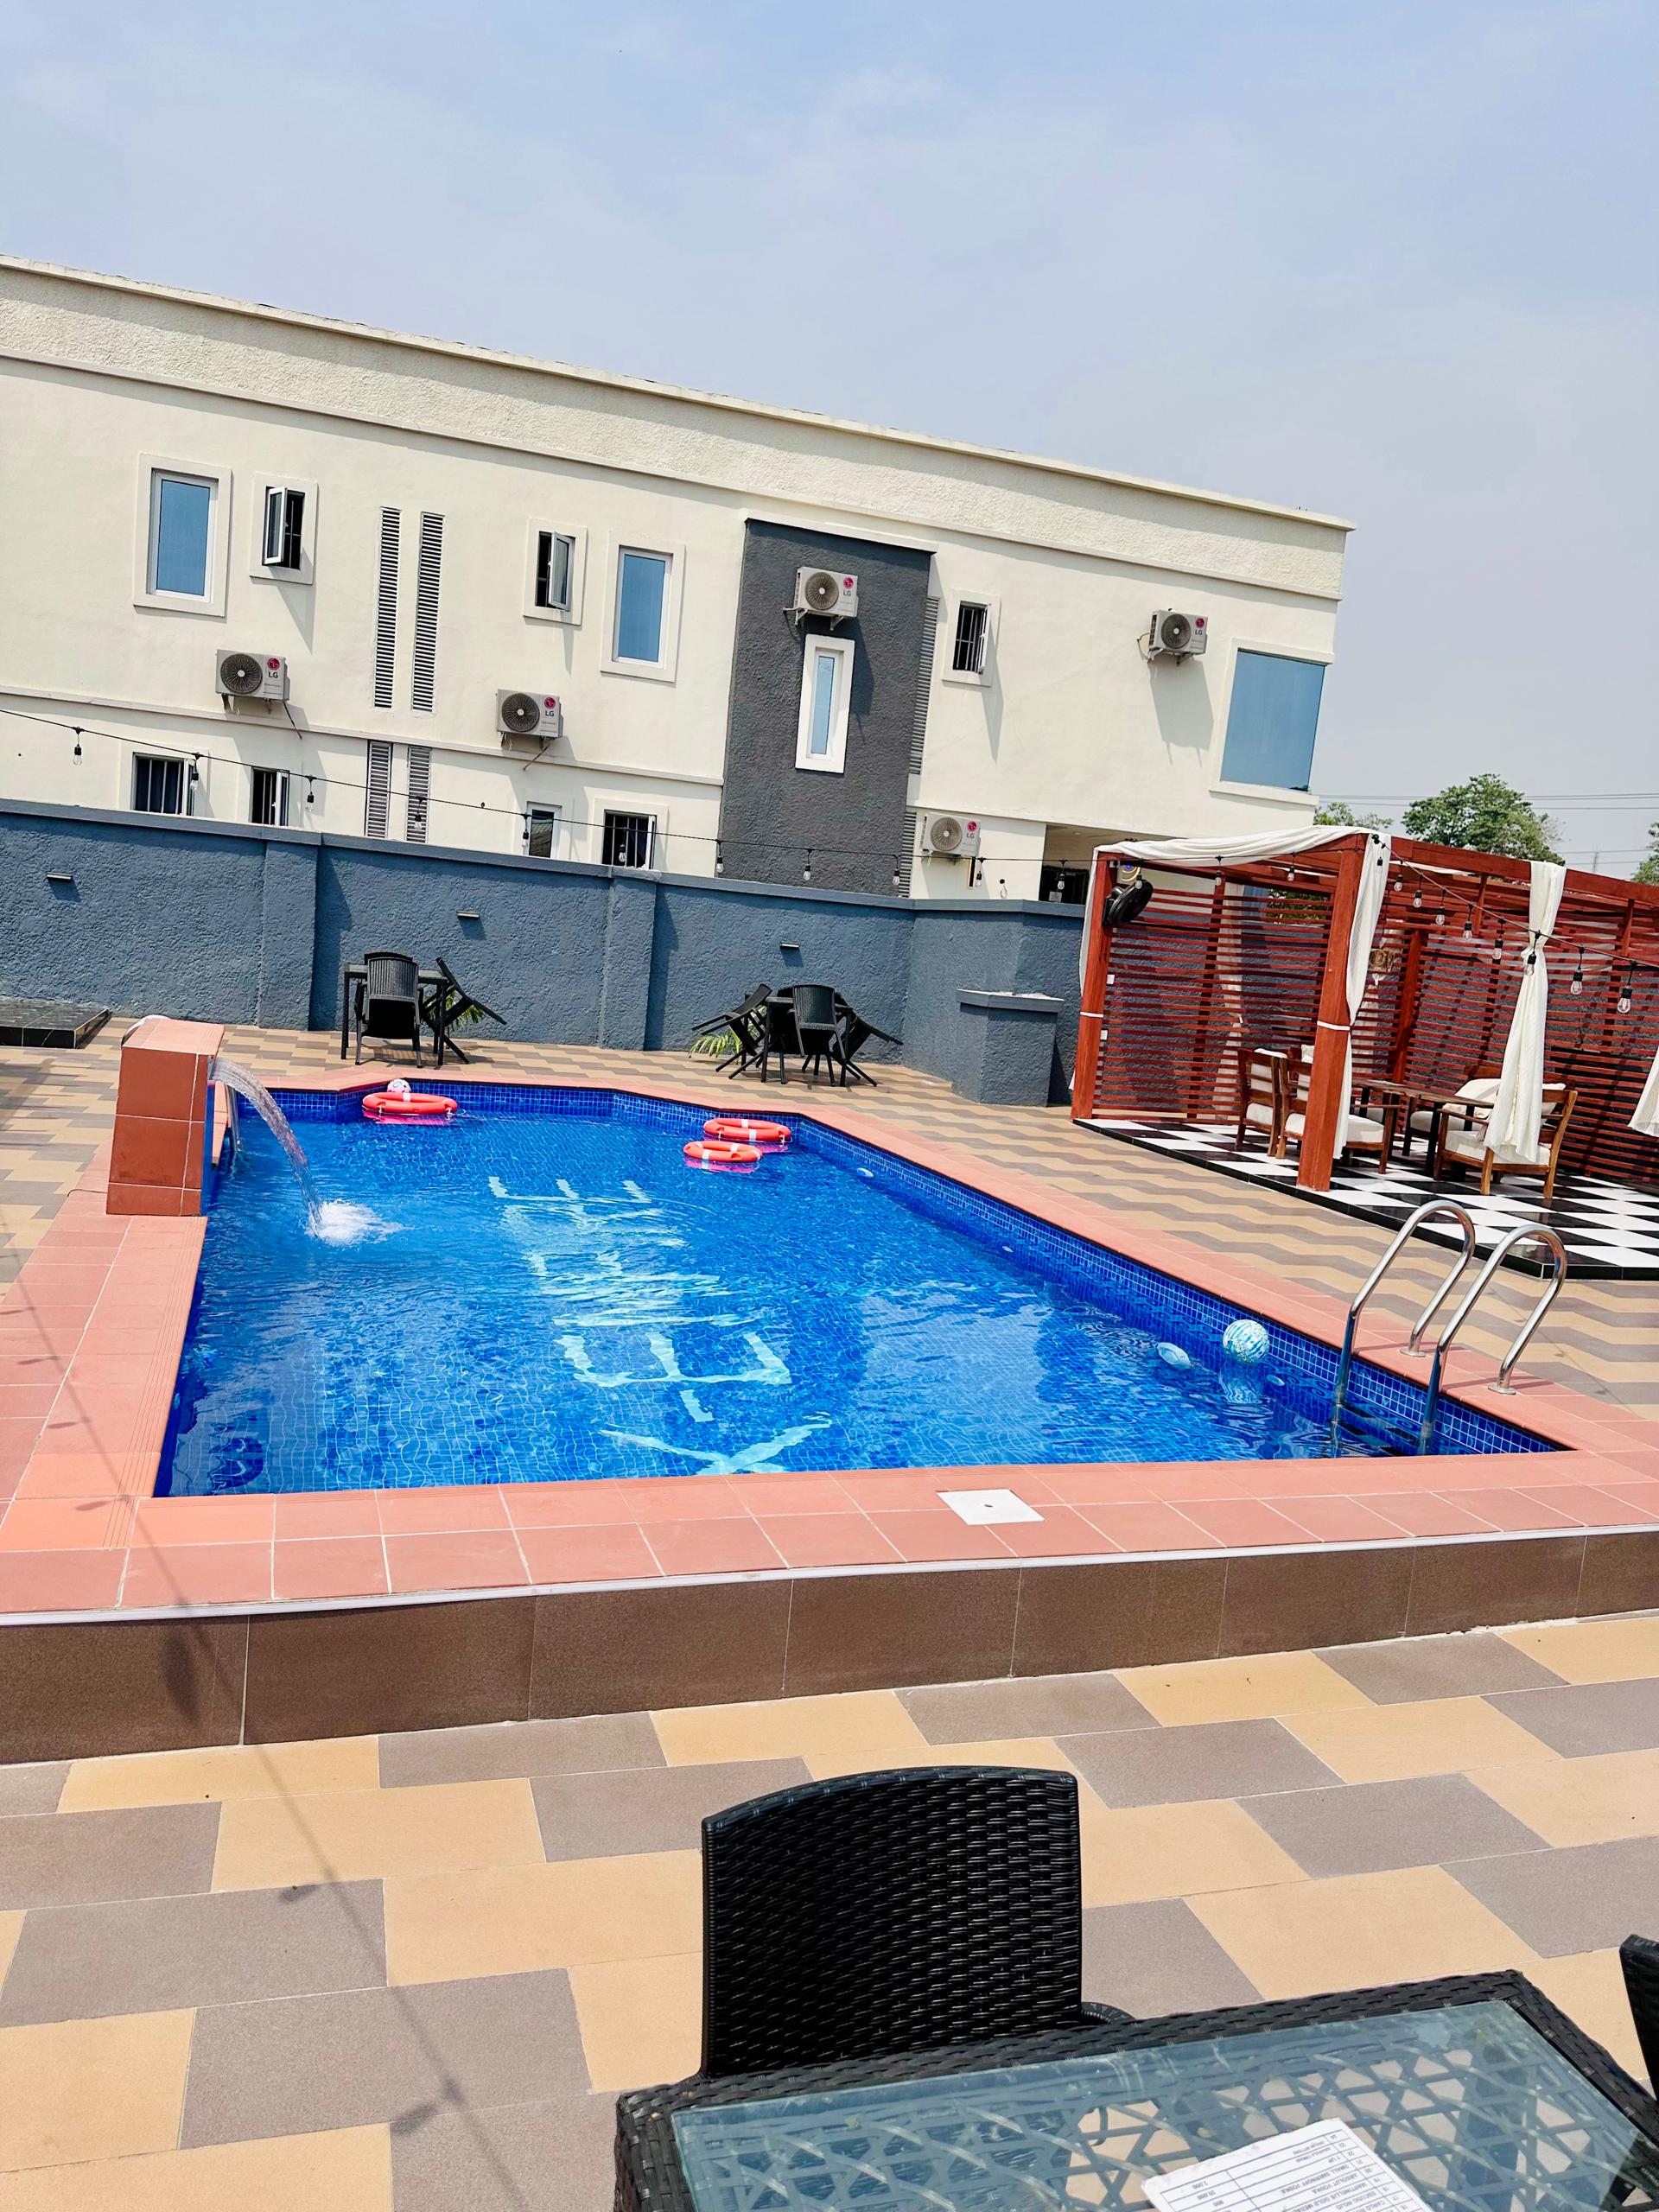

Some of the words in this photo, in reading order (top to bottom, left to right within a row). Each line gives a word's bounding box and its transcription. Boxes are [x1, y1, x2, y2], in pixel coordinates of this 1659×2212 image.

[1331, 2164, 1349, 2175] SMALL
[1301, 2171, 1330, 2186] SMIRNOFF
[1333, 2173, 1357, 2186] ABSOLUT
[1281, 2183, 1300, 2195] VODKA
[1312, 2183, 1332, 2194] VODKA
[1313, 2196, 1329, 2207] GOLD
[1352, 2191, 1376, 2202] ESCUDO
[1336, 2202, 1352, 2210] ROJO
[1366, 2201, 1385, 2211] CARLO
